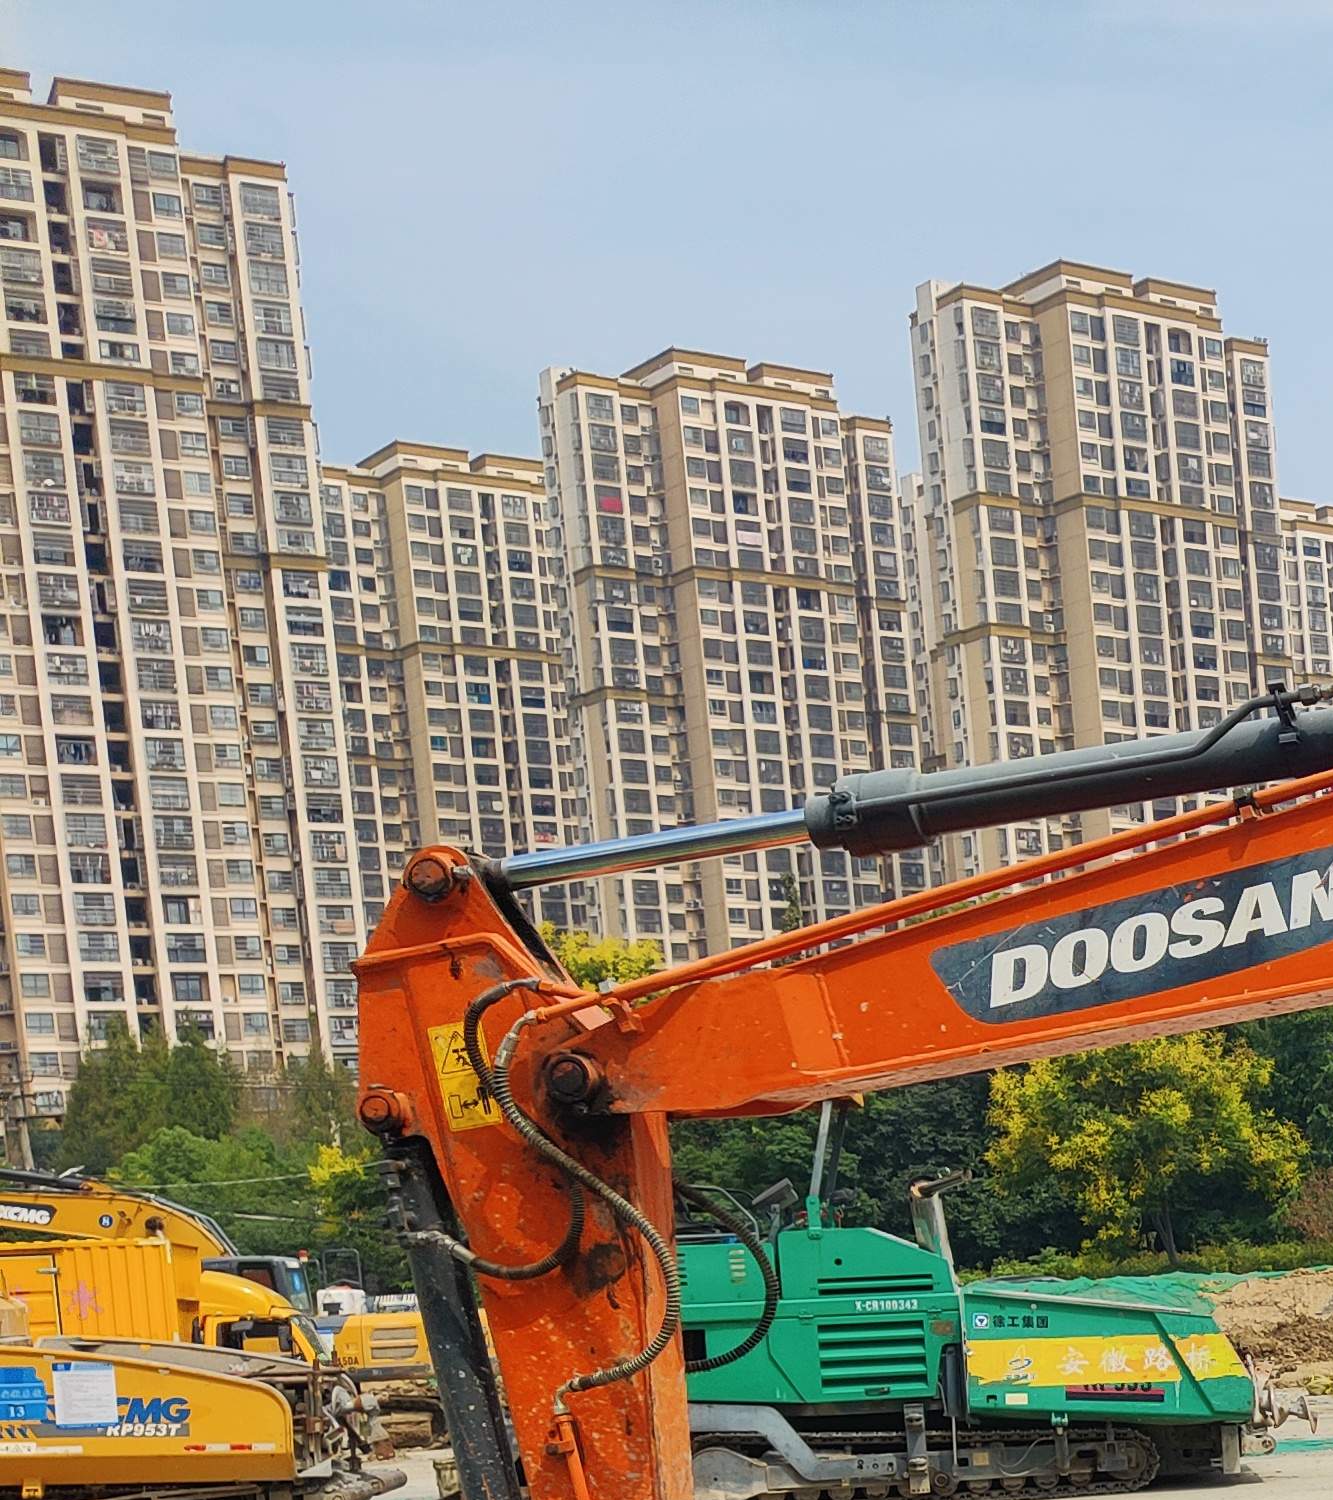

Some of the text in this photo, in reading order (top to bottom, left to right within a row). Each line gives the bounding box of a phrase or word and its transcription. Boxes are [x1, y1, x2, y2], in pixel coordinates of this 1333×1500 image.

[992, 1315, 1049, 1329] 徐工集团
[9, 1405, 26, 1419] 13
